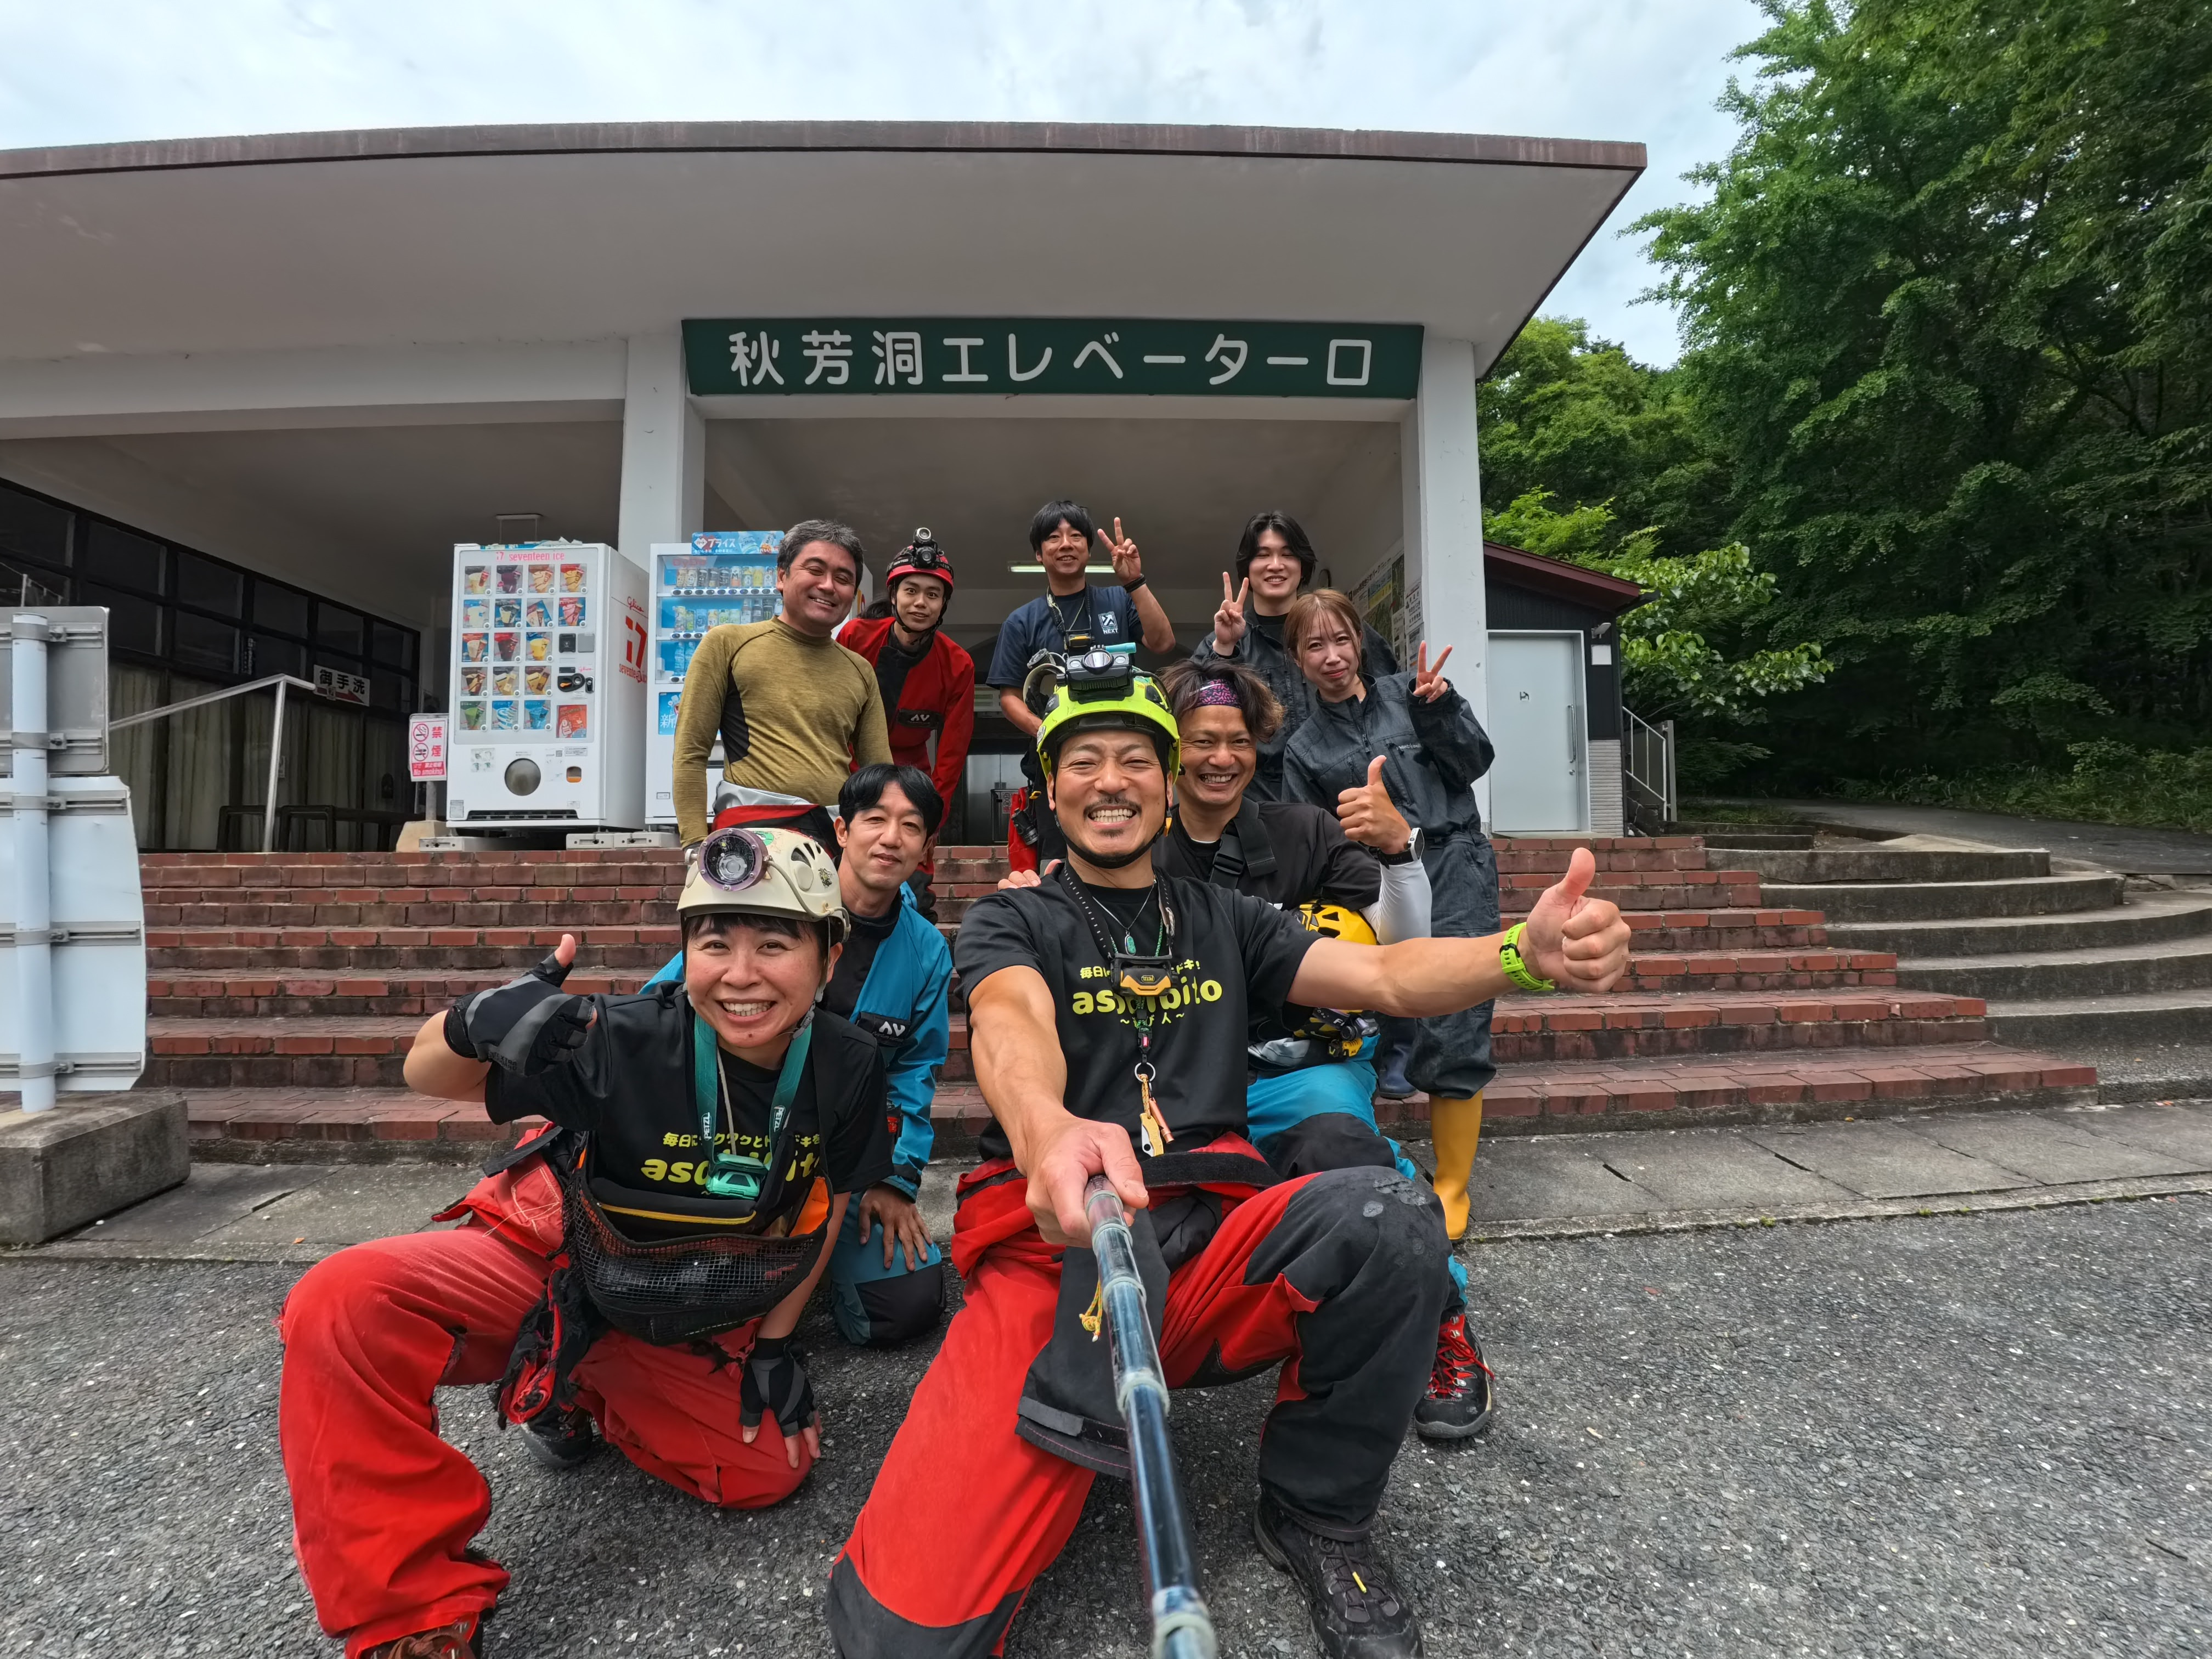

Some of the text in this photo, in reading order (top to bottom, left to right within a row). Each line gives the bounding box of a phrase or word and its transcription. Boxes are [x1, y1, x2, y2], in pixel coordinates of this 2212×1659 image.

[728, 330, 1372, 386] 秋芳洞エレベーター口
[509, 552, 550, 561] seventeen
[553, 550, 565, 560] ice
[320, 669, 365, 695] 御手洗
[702, 1112, 712, 1139] PETZL
[774, 1105, 785, 1132] PETZL
